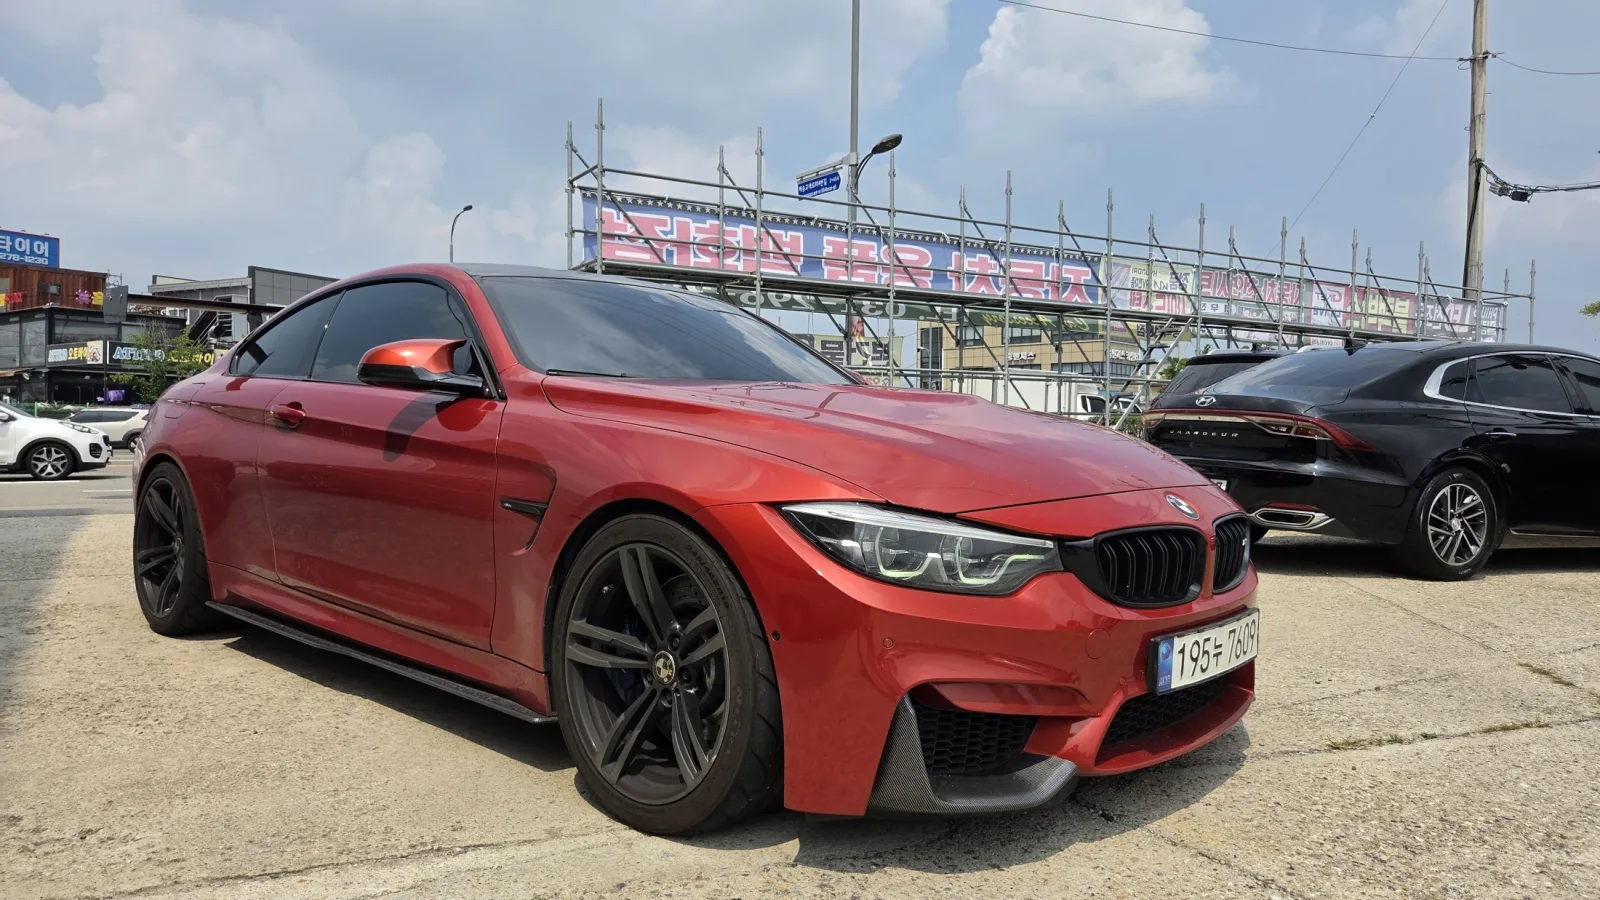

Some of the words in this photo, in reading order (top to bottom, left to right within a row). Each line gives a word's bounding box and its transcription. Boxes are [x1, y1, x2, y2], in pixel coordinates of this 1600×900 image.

[0, 235, 49, 257] 타이어
[1169, 429, 1239, 438] GRANDEUR
[1177, 636, 1223, 681] 195누
[1227, 618, 1256, 664] 7609
